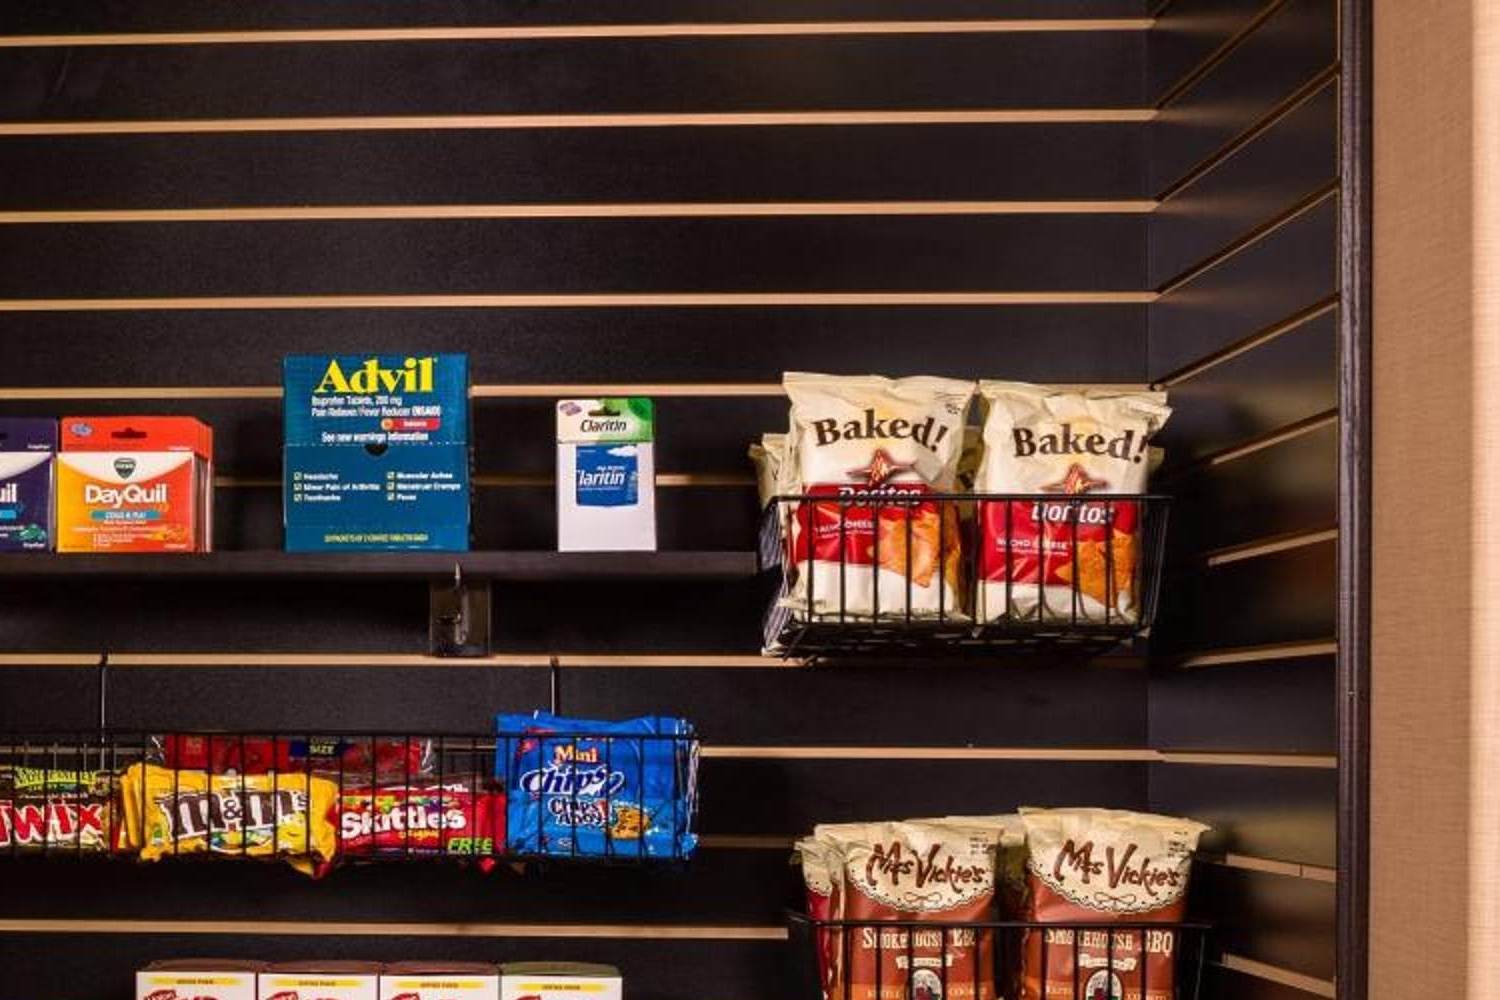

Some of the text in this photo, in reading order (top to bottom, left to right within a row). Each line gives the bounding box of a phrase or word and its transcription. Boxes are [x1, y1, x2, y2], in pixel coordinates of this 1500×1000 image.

[314, 357, 433, 393] Advil
[580, 419, 627, 432] Claritin
[813, 409, 949, 452] Baked!
[1012, 423, 1148, 464] Baked!
[579, 469, 625, 486] laritin
[84, 484, 167, 508] DayQuil
[310, 745, 334, 754] SIZE
[555, 744, 597, 764] Mini
[341, 804, 466, 839] Skittles
